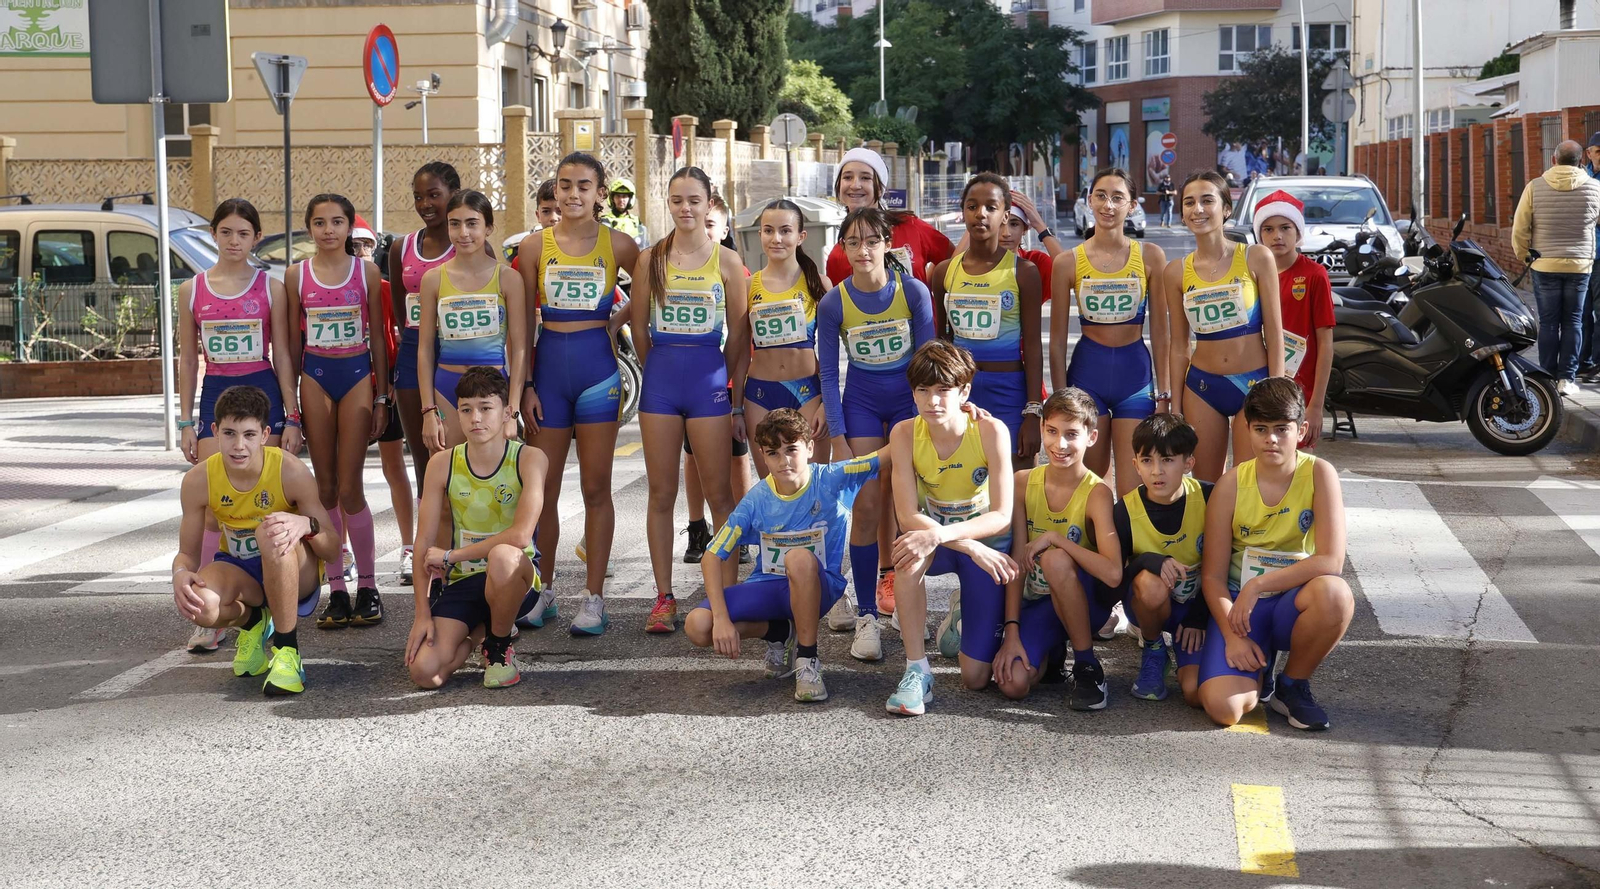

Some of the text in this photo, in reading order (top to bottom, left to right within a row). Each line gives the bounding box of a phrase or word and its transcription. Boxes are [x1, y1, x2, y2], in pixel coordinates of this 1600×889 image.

[0, 31, 85, 51] ARQUE
[550, 281, 598, 299] 753
[1085, 294, 1133, 312] 642
[1188, 301, 1238, 323] 702
[444, 309, 492, 329] 695
[661, 305, 708, 324] 669
[949, 309, 993, 329] 610
[311, 321, 357, 340] 715
[754, 315, 797, 337] 691
[208, 334, 254, 353] 661
[855, 335, 904, 355] 616
